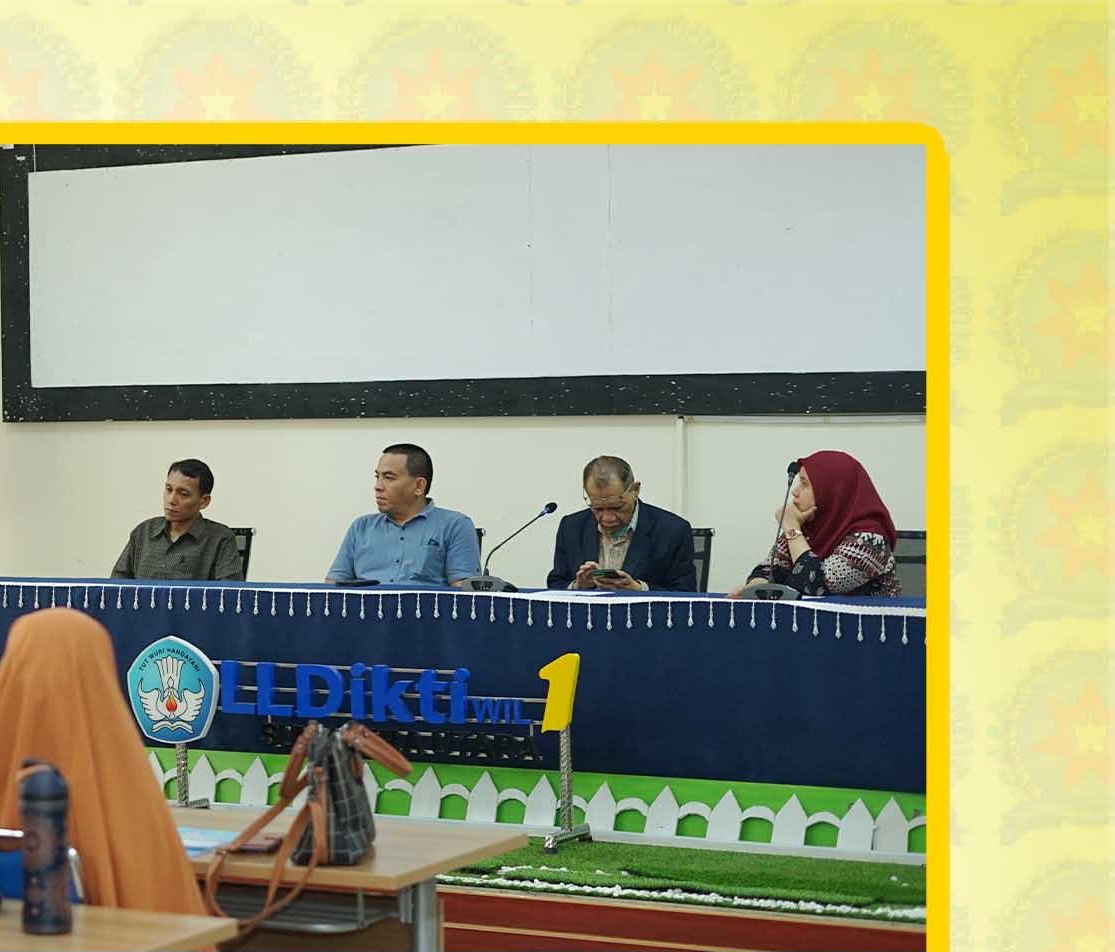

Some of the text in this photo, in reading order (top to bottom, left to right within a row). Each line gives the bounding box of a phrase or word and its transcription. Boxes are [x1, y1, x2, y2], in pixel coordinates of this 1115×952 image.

[139, 648, 200, 672] TUT WURI HANDAYANI
[221, 660, 471, 725] LLDikti
[538, 653, 581, 734] 1
